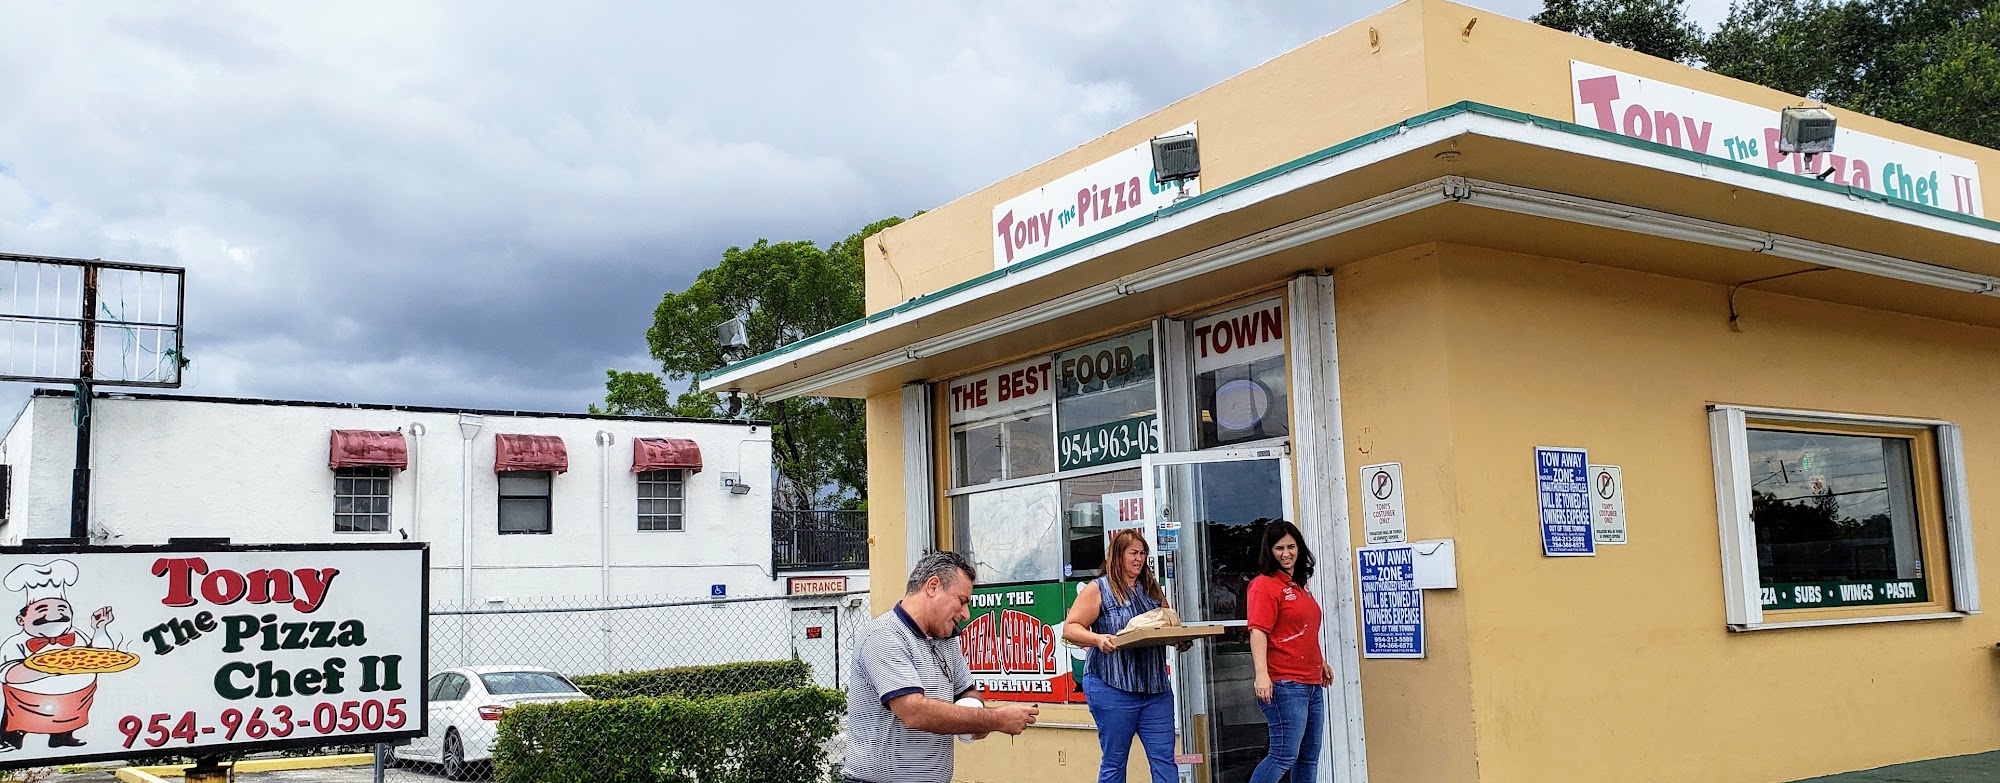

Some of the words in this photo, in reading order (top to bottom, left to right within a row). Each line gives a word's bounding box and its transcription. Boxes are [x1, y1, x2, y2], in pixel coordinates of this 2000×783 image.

[1578, 75, 1713, 156] Tony
[1724, 135, 1759, 161] The
[1882, 162, 1939, 206] Chef
[1951, 174, 1978, 217] II
[997, 208, 1054, 263] Tony
[1057, 204, 1076, 230] The
[1077, 176, 1142, 228] Pizza
[952, 378, 988, 413] THE
[998, 362, 1052, 403] BEST
[1062, 345, 1133, 389] FOOD
[1195, 306, 1283, 359] TOWN
[1061, 421, 1159, 467] 954-963-05
[1541, 452, 1559, 467] TOW
[1561, 453, 1582, 468] AWAY
[1553, 468, 1574, 483] ZONE
[1542, 492, 1555, 508] WILL
[1555, 493, 1562, 508] BE
[1562, 493, 1581, 508] TOWED
[1582, 493, 1588, 508] AT
[1379, 517, 1390, 525] ONLY
[1543, 508, 1566, 525] OWNERS
[1566, 509, 1590, 525] EXPENSE
[1363, 551, 1385, 567] TOW
[1387, 549, 1412, 566] AWAY
[1377, 566, 1404, 582] ZONE
[151, 556, 340, 614] Tony
[794, 581, 842, 593] ENTRANCE
[1363, 581, 1397, 592] UNAUTHORIZED
[1760, 587, 1778, 605] ZZA
[1794, 585, 1822, 604] SUBS
[1839, 584, 1874, 601] WINGS
[1885, 582, 1916, 599] PASTA
[970, 593, 1003, 608] TONY
[1006, 591, 1035, 606] THE
[1363, 591, 1379, 609] WILL
[1380, 591, 1388, 608] BE
[1388, 590, 1411, 608] TOWED
[1412, 590, 1419, 607] AT
[1365, 608, 1392, 625] OWNERS
[1393, 607, 1420, 624] EXPENSE
[142, 609, 219, 656] The
[221, 613, 367, 654] Pizza
[960, 610, 1001, 673] PIZZA
[1000, 609, 1041, 674] CHEF
[1042, 624, 1057, 674] 2
[213, 656, 347, 701] Chef
[357, 654, 403, 693] II
[989, 679, 1053, 692] DELIVER
[118, 697, 407, 749] 954-963-0505
